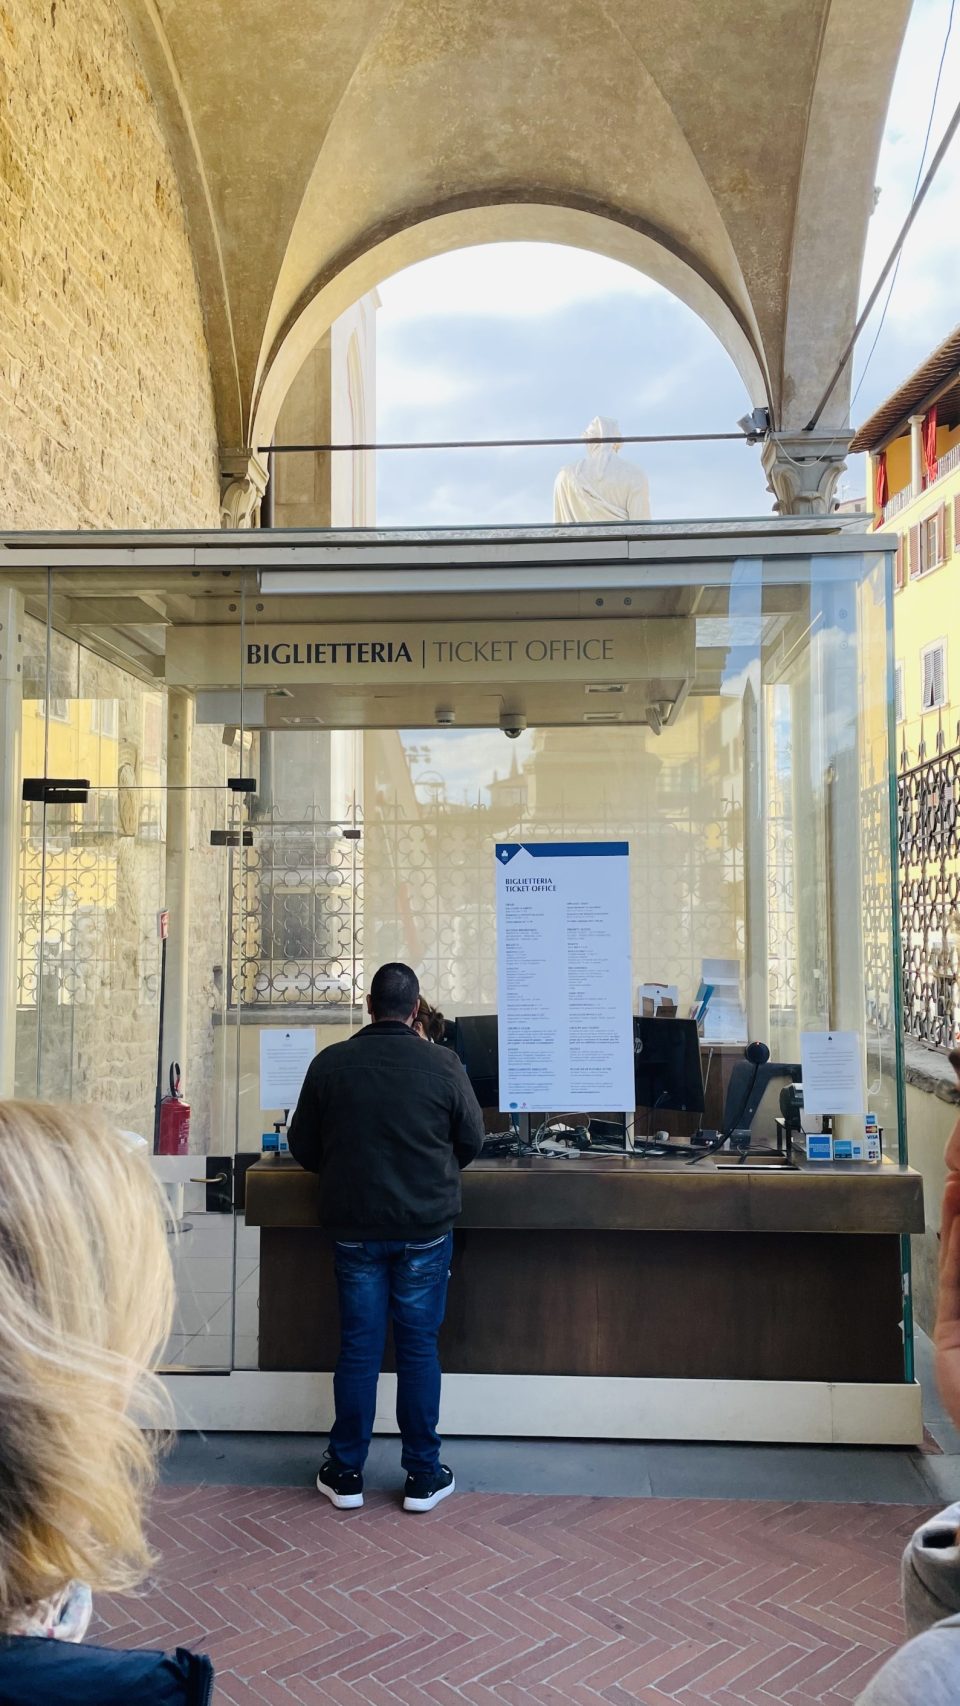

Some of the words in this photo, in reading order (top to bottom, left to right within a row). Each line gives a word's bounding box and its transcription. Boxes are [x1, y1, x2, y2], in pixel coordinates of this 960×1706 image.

[246, 641, 413, 665] BIGLIETTERIA
[433, 640, 518, 663] TICKET
[525, 638, 614, 662] OFFICE
